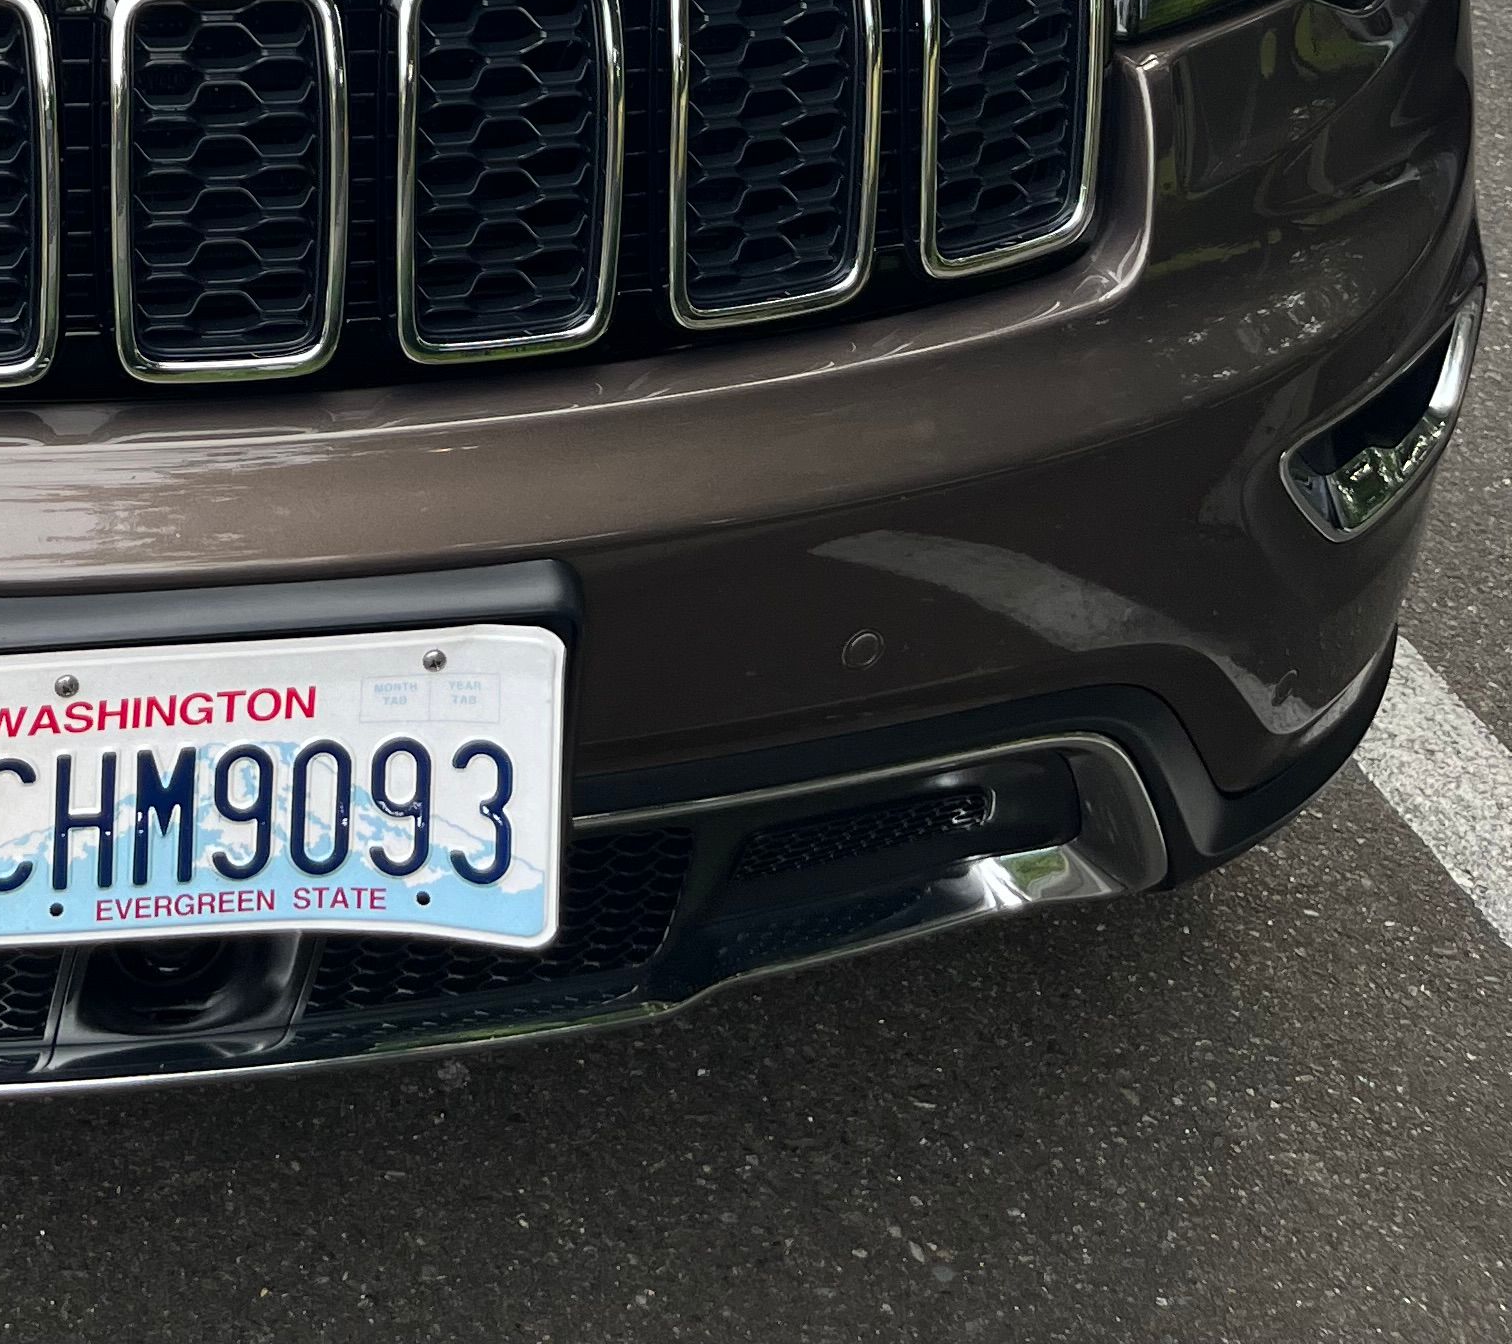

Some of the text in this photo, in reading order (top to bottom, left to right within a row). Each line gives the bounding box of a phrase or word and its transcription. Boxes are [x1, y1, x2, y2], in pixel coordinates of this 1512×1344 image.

[374, 681, 418, 693] MONTH
[449, 680, 482, 691] YEAR
[383, 696, 408, 706] TAB
[452, 694, 477, 705] TAB
[95, 885, 388, 922] EVERGREEN STATE
